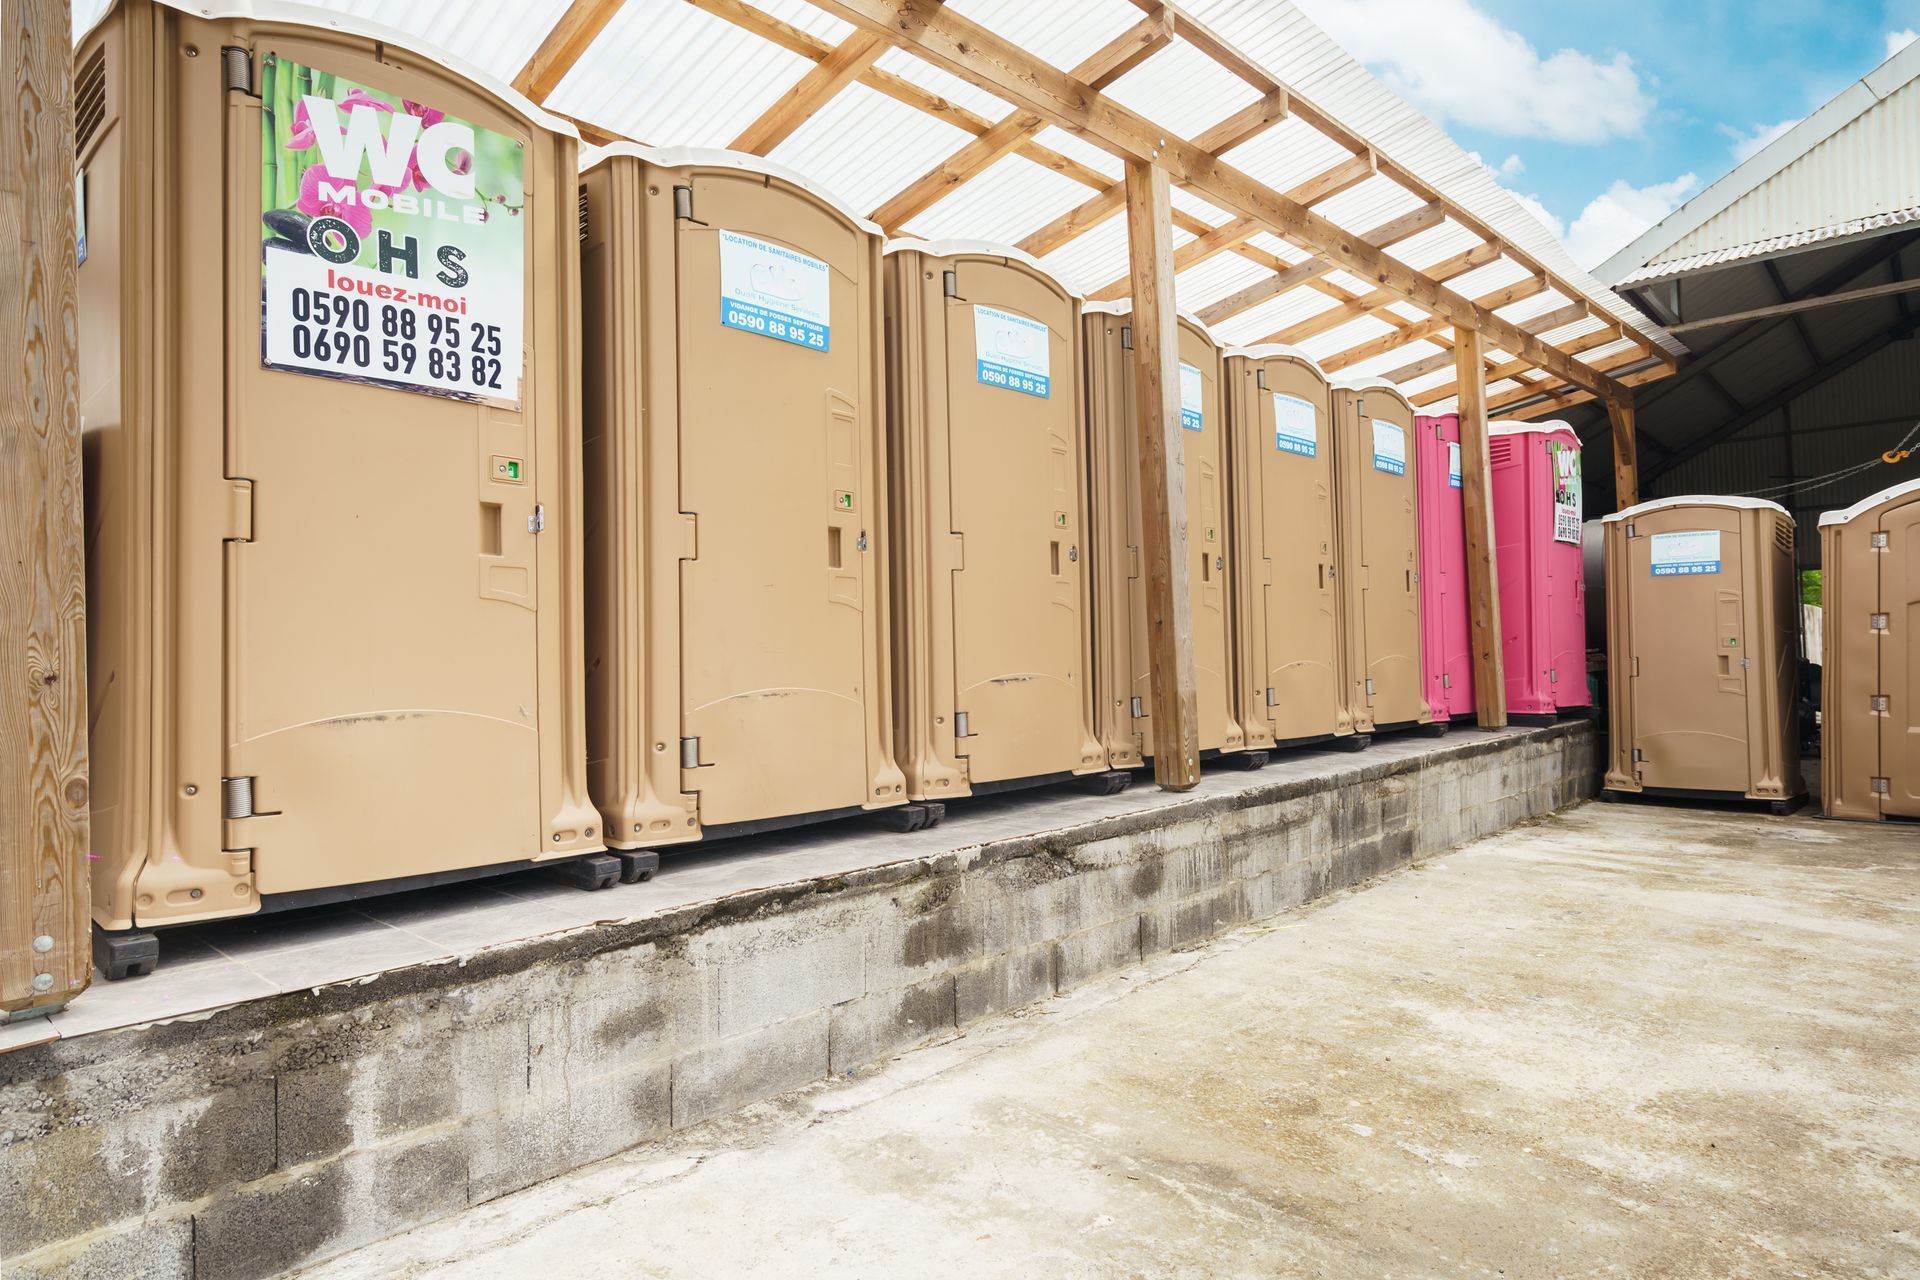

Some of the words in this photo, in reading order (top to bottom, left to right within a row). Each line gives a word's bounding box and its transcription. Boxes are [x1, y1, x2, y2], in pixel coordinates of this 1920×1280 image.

[302, 95, 475, 199] WC
[318, 181, 486, 225] MOBILE
[758, 243, 767, 252] DE
[768, 246, 802, 263] SANITAIRES
[327, 269, 468, 315] louez-moi
[292, 287, 370, 333] 0590
[381, 305, 416, 341] 88
[427, 314, 460, 349] 95
[470, 322, 502, 356] 25
[728, 310, 765, 331] 0590
[769, 320, 786, 336] 88
[789, 327, 806, 342] 95
[808, 331, 824, 347] 25
[292, 325, 371, 368] 0690
[383, 340, 417, 374] 59
[428, 348, 461, 382] 83
[471, 356, 502, 390] 82
[982, 369, 1006, 385] 0590
[1008, 376, 1020, 388] 88
[1022, 380, 1033, 391] 95
[1035, 383, 1046, 394] 25
[1182, 415, 1191, 426] 95
[1191, 417, 1200, 428] 25
[1279, 439, 1293, 450] 0590
[1308, 446, 1315, 456] 25
[1557, 448, 1576, 477] WC
[1655, 567, 1676, 575] 0590
